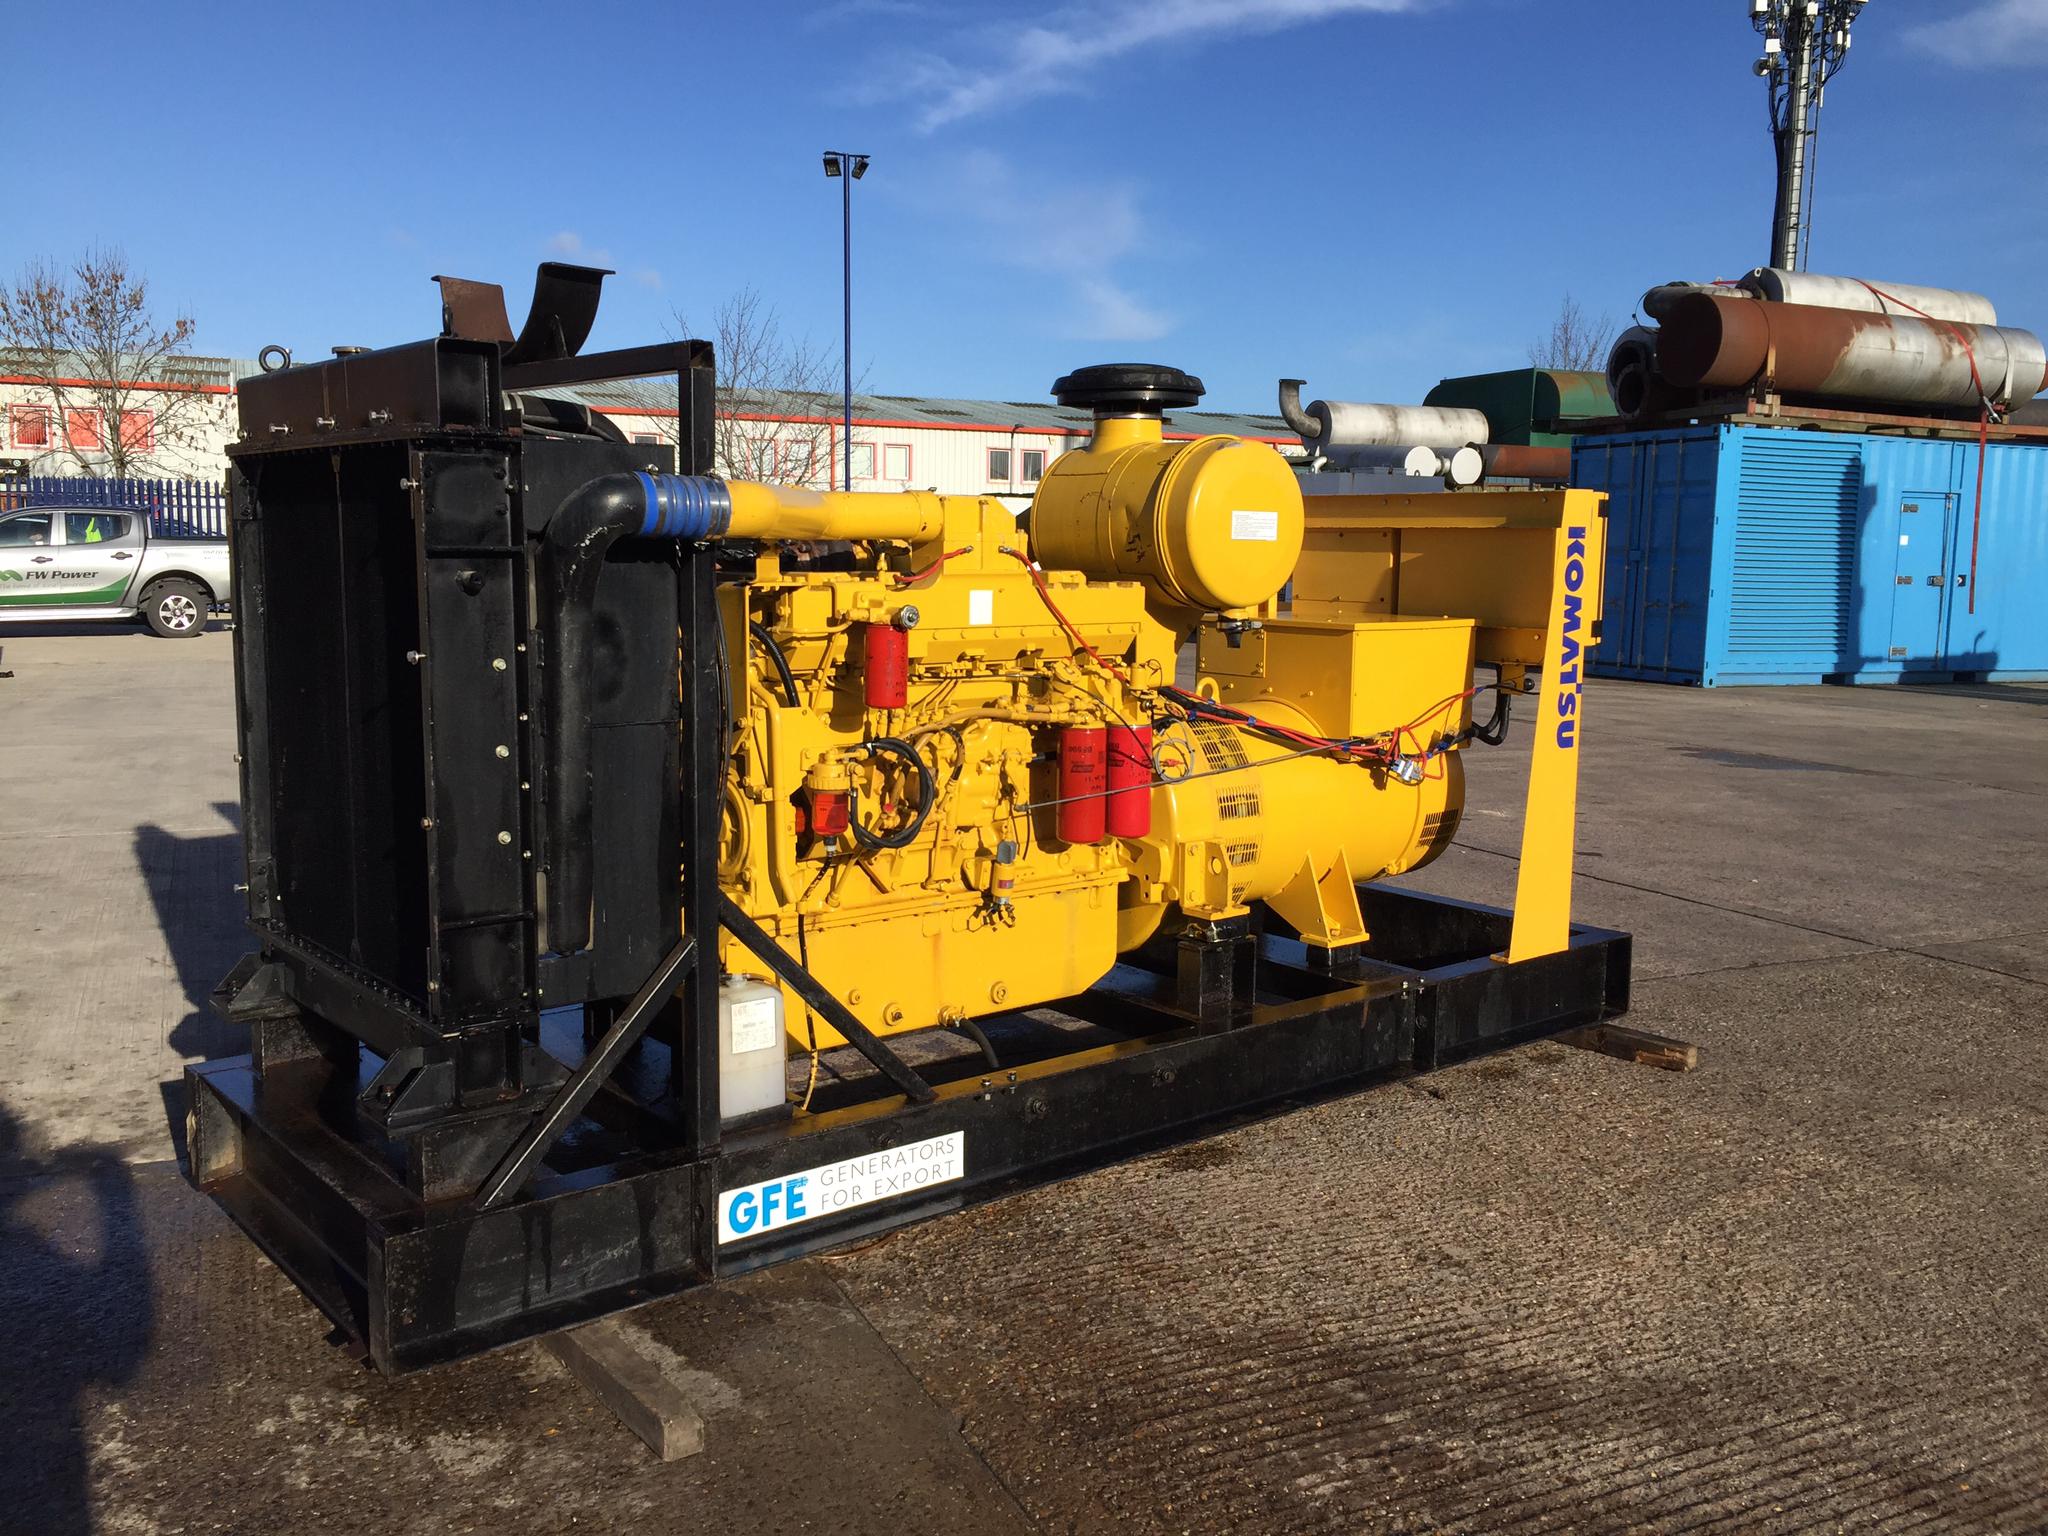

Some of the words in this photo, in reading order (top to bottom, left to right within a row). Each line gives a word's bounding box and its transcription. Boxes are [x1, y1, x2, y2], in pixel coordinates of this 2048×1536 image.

[26, 571, 49, 580] FW
[51, 570, 99, 579] Power
[1556, 526, 1586, 749] KOMATSU
[820, 1138, 955, 1186] GENERATORS
[821, 1186, 863, 1210] FOR
[874, 1160, 956, 1195] EXPORT
[728, 1177, 808, 1234] GFE
